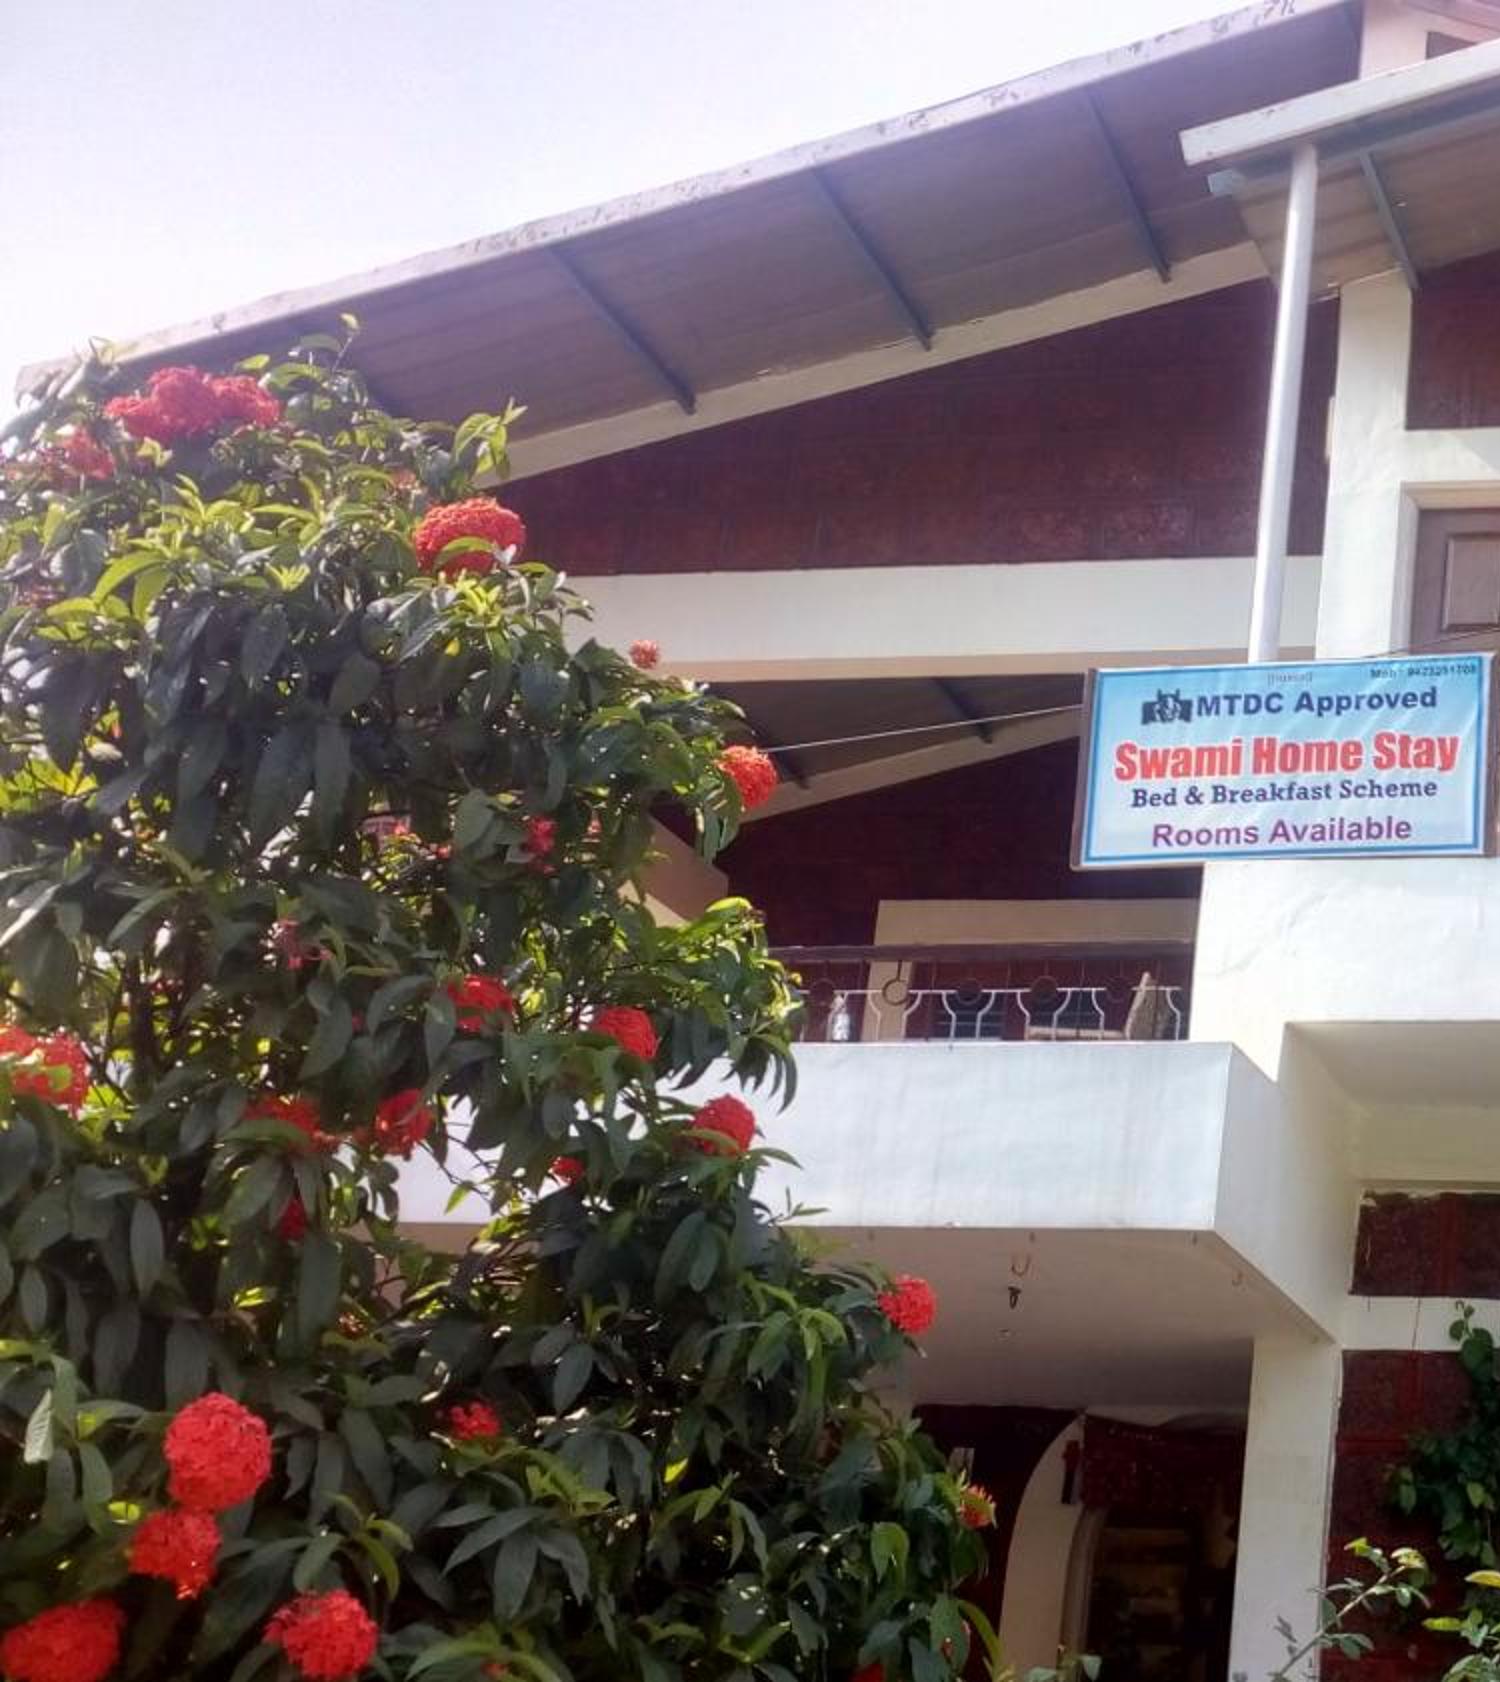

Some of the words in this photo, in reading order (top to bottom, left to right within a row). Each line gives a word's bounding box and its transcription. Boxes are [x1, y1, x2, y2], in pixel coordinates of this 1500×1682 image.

[1196, 692, 1284, 716] MTDC
[1294, 686, 1437, 717] Approved
[1115, 739, 1242, 781] Swami
[1252, 734, 1363, 775] Home
[1373, 731, 1460, 773] Stay
[1131, 787, 1177, 808] Bed
[1185, 787, 1204, 805] &
[1212, 783, 1332, 803] Breakfast
[1339, 780, 1438, 798] Scheme
[1152, 822, 1259, 847] Rooms
[1269, 816, 1412, 844] Available
